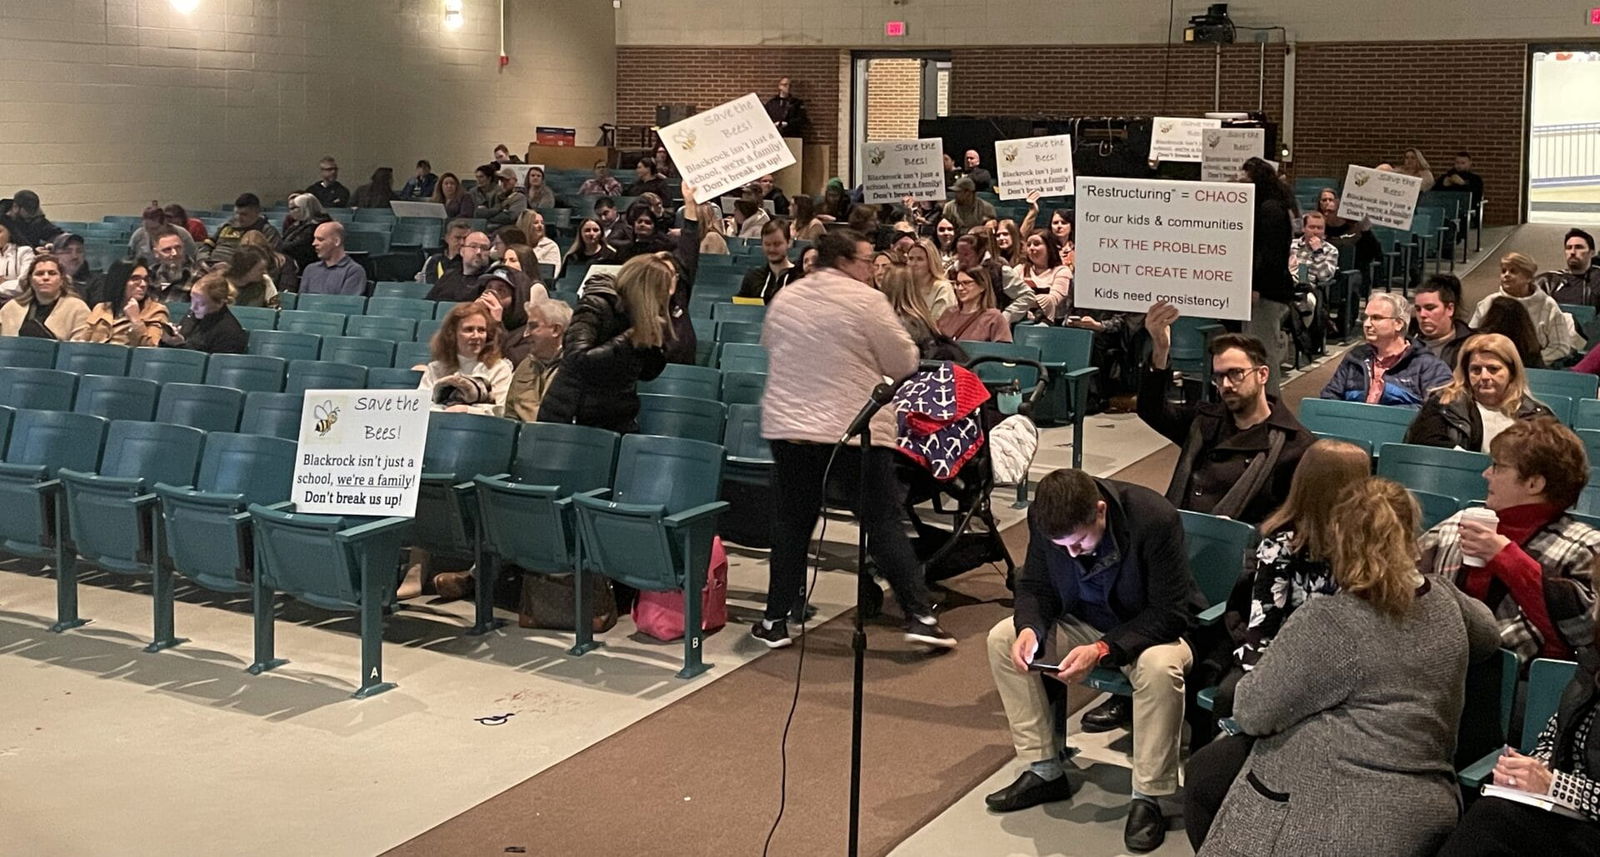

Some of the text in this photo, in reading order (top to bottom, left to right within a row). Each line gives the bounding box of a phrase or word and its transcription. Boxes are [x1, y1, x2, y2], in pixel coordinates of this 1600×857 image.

[703, 97, 754, 126] Save the
[721, 120, 753, 139] Bees!
[685, 132, 775, 174] Blackrock isn't just a
[894, 142, 936, 152] Save the
[1025, 139, 1065, 150] Save the
[689, 169, 721, 185] school,
[722, 157, 746, 172] we're
[753, 142, 784, 160] family!
[702, 154, 782, 193] Don't break us up!
[872, 192, 892, 200] Don't
[1082, 184, 1176, 203] "Restructuring"
[1194, 189, 1248, 204] CHAOS
[1085, 211, 1244, 231] for our kids & communities
[1099, 237, 1227, 256] FIX THE PROBLEMS
[1092, 262, 1233, 282] DON'T CREATE MORE
[1094, 287, 1230, 310] Kids need consistency!
[354, 395, 419, 412] Save the
[364, 425, 402, 440] Bees!
[303, 453, 414, 470] Blackrock isn't just a
[296, 472, 416, 489] school, we're a family!
[304, 490, 402, 509] Don't break us up!
[692, 636, 699, 649] B
[370, 666, 379, 679] A
